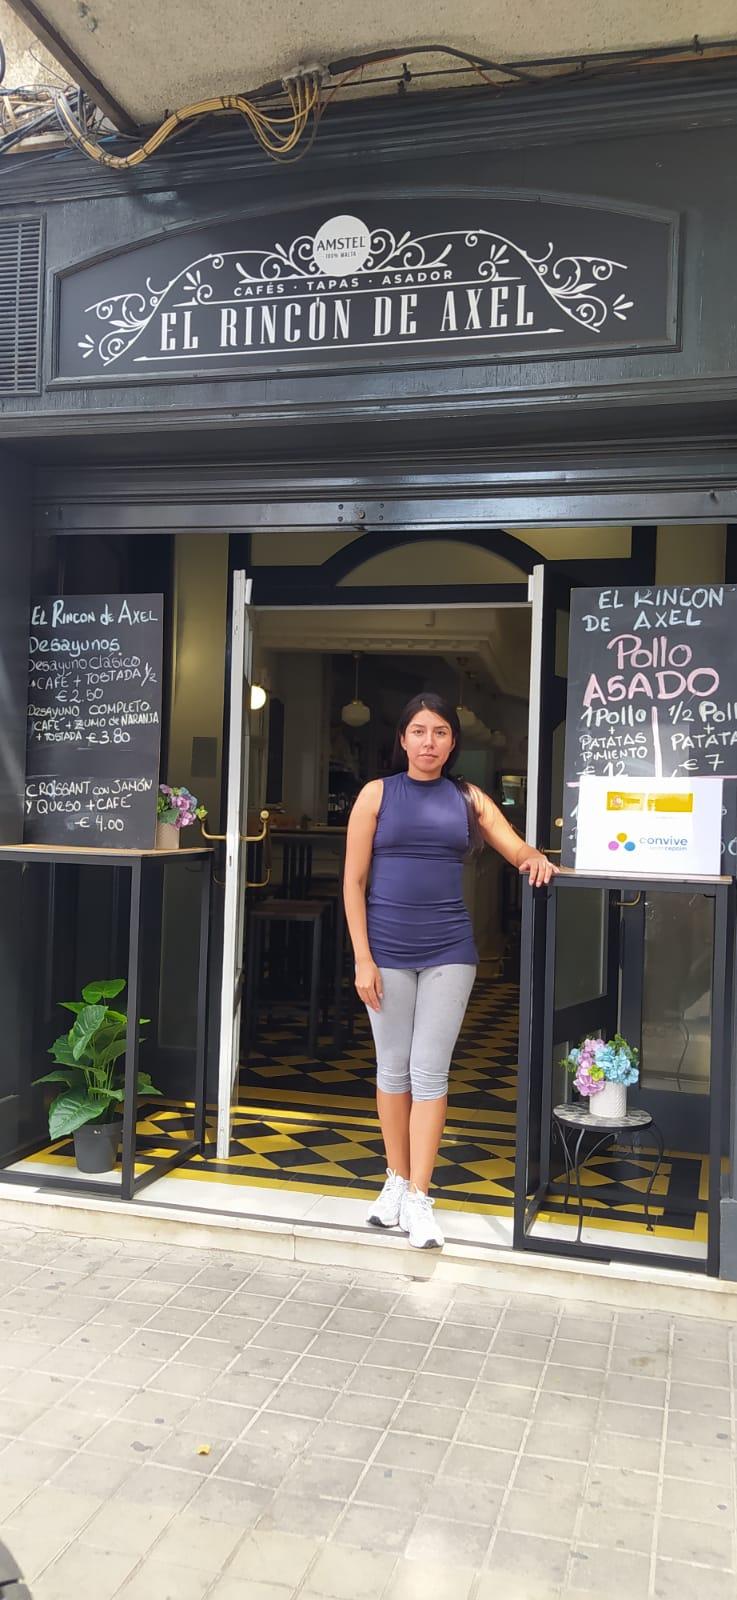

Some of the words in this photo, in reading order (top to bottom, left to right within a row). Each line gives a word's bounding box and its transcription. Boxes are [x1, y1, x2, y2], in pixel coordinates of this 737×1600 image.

[316, 236, 366, 251] AMSTEL
[234, 282, 285, 297] CAFÉS
[307, 277, 360, 291] TAPAS
[382, 270, 453, 285] ASADOR
[160, 310, 199, 351] EL
[219, 297, 351, 347] RINCÓN
[373, 293, 418, 337] DE
[440, 285, 534, 332] AXEL
[599, 589, 624, 609] EL
[31, 605, 48, 625] EL
[118, 599, 158, 626] AXEL
[582, 615, 611, 632] DE
[633, 609, 702, 631] AXEL
[29, 636, 121, 657] Desayunos
[606, 634, 693, 670] Pollo
[29, 659, 87, 677] Desayuno
[86, 669, 141, 685] TOSTADA
[582, 667, 720, 707] ASADO
[89, 700, 150, 715] COMPLETO
[34, 717, 65, 731] CAFÉ
[121, 712, 160, 727] NARANJA
[44, 732, 82, 741] TOSTADA
[579, 732, 647, 750] PATATAS
[580, 746, 648, 762] PIMIENTO
[705, 753, 725, 772] 7
[602, 760, 628, 777] 12
[111, 778, 153, 794] JAMÓN
[95, 815, 124, 832] 4.00
[639, 836, 688, 846] convive
